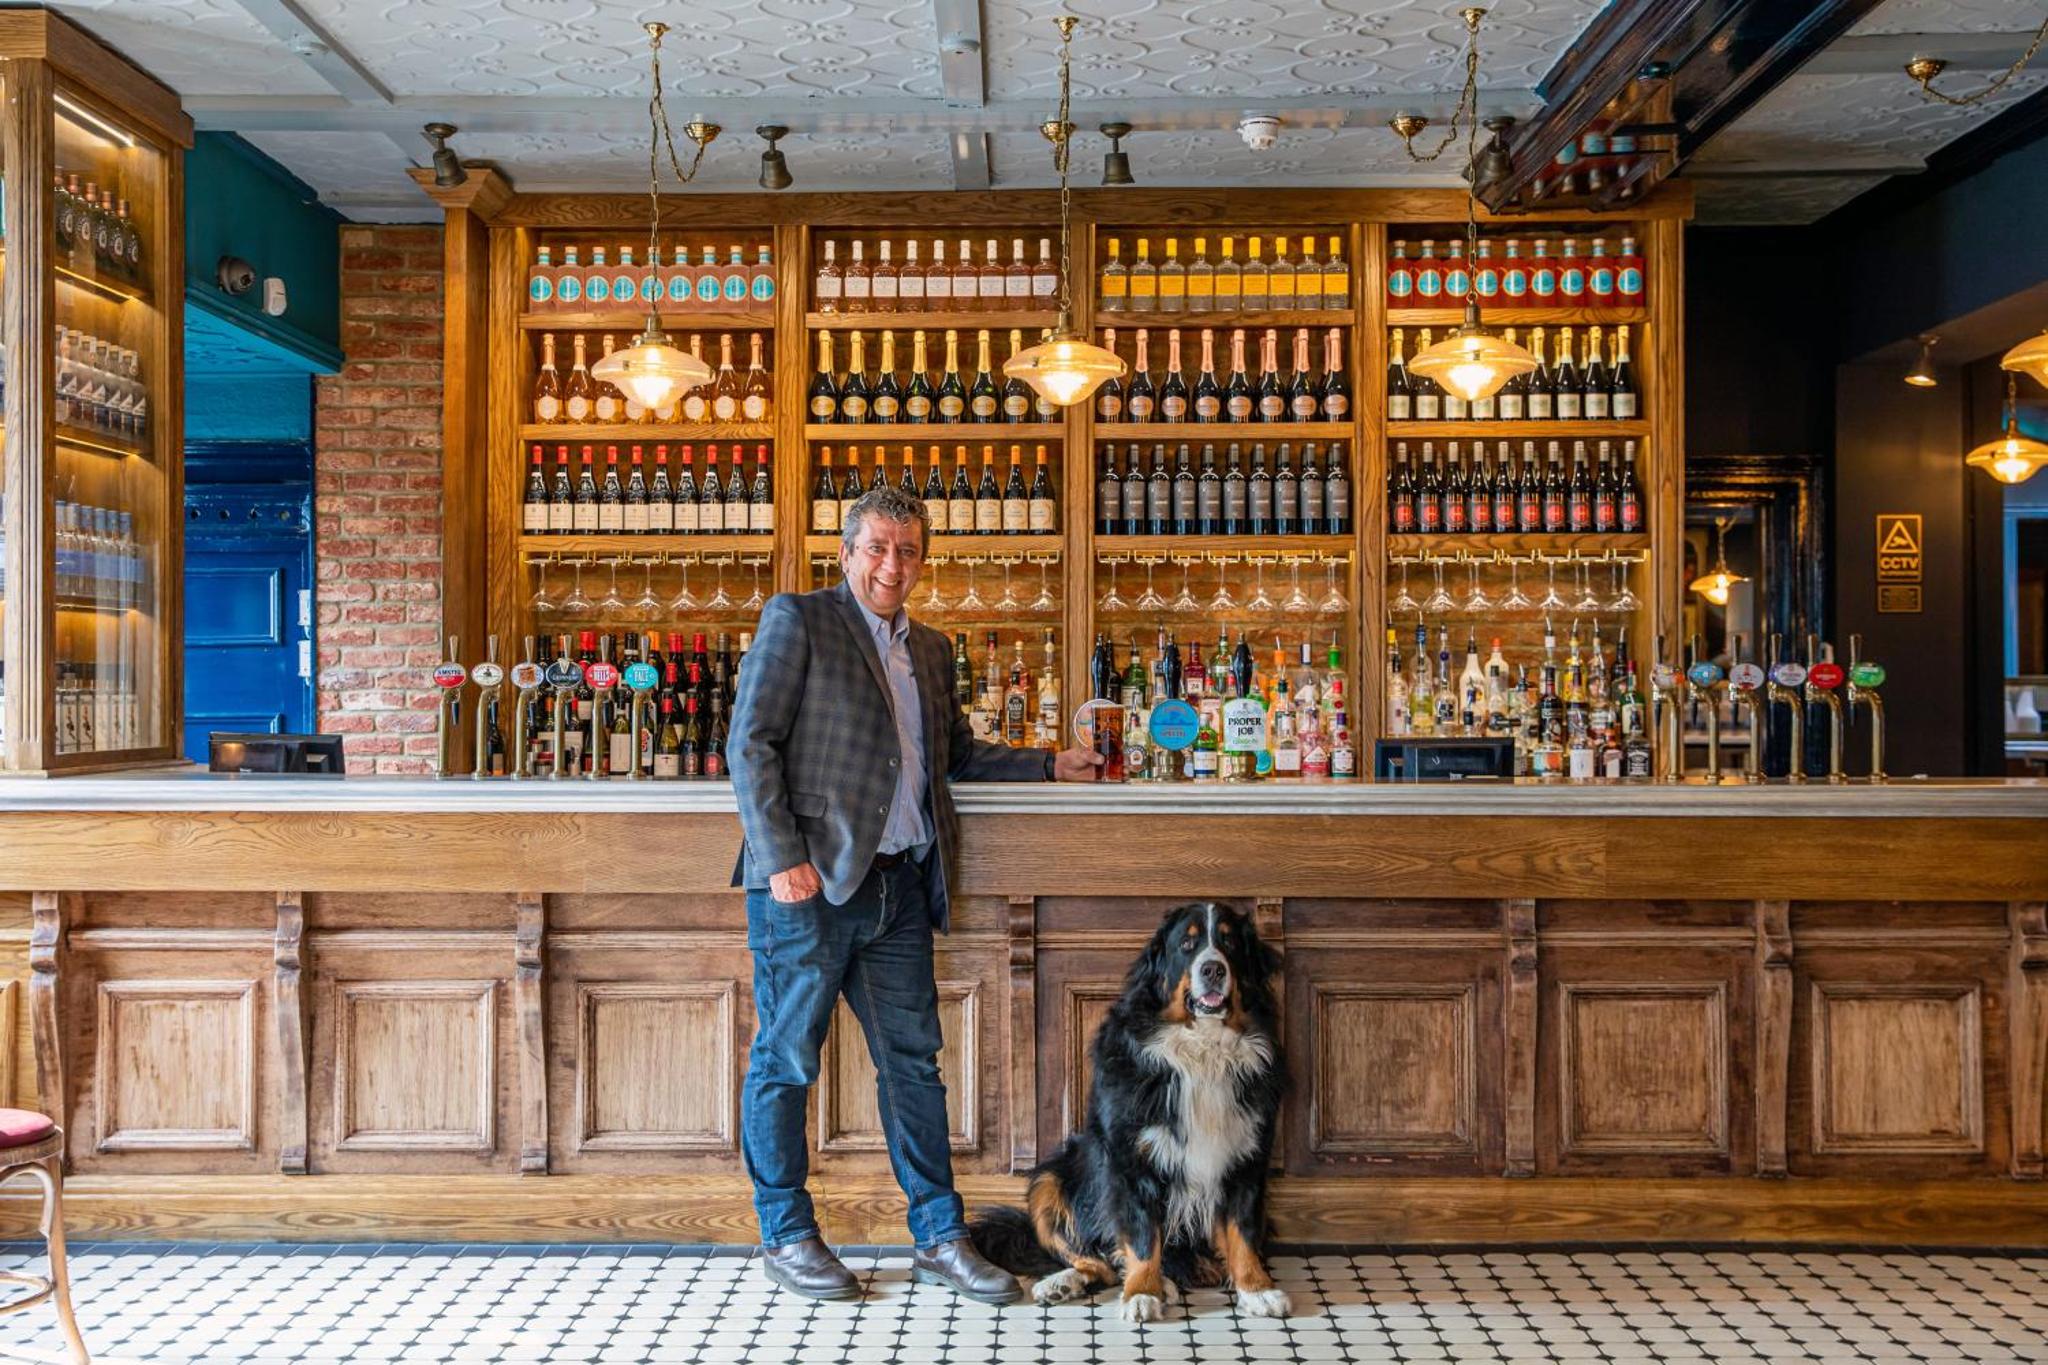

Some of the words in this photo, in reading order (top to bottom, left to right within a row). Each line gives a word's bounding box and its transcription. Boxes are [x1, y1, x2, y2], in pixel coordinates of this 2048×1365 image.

[1880, 557, 1919, 569] CCTV
[1228, 717, 1262, 726] PROPER
[1237, 727, 1255, 736] JOB
